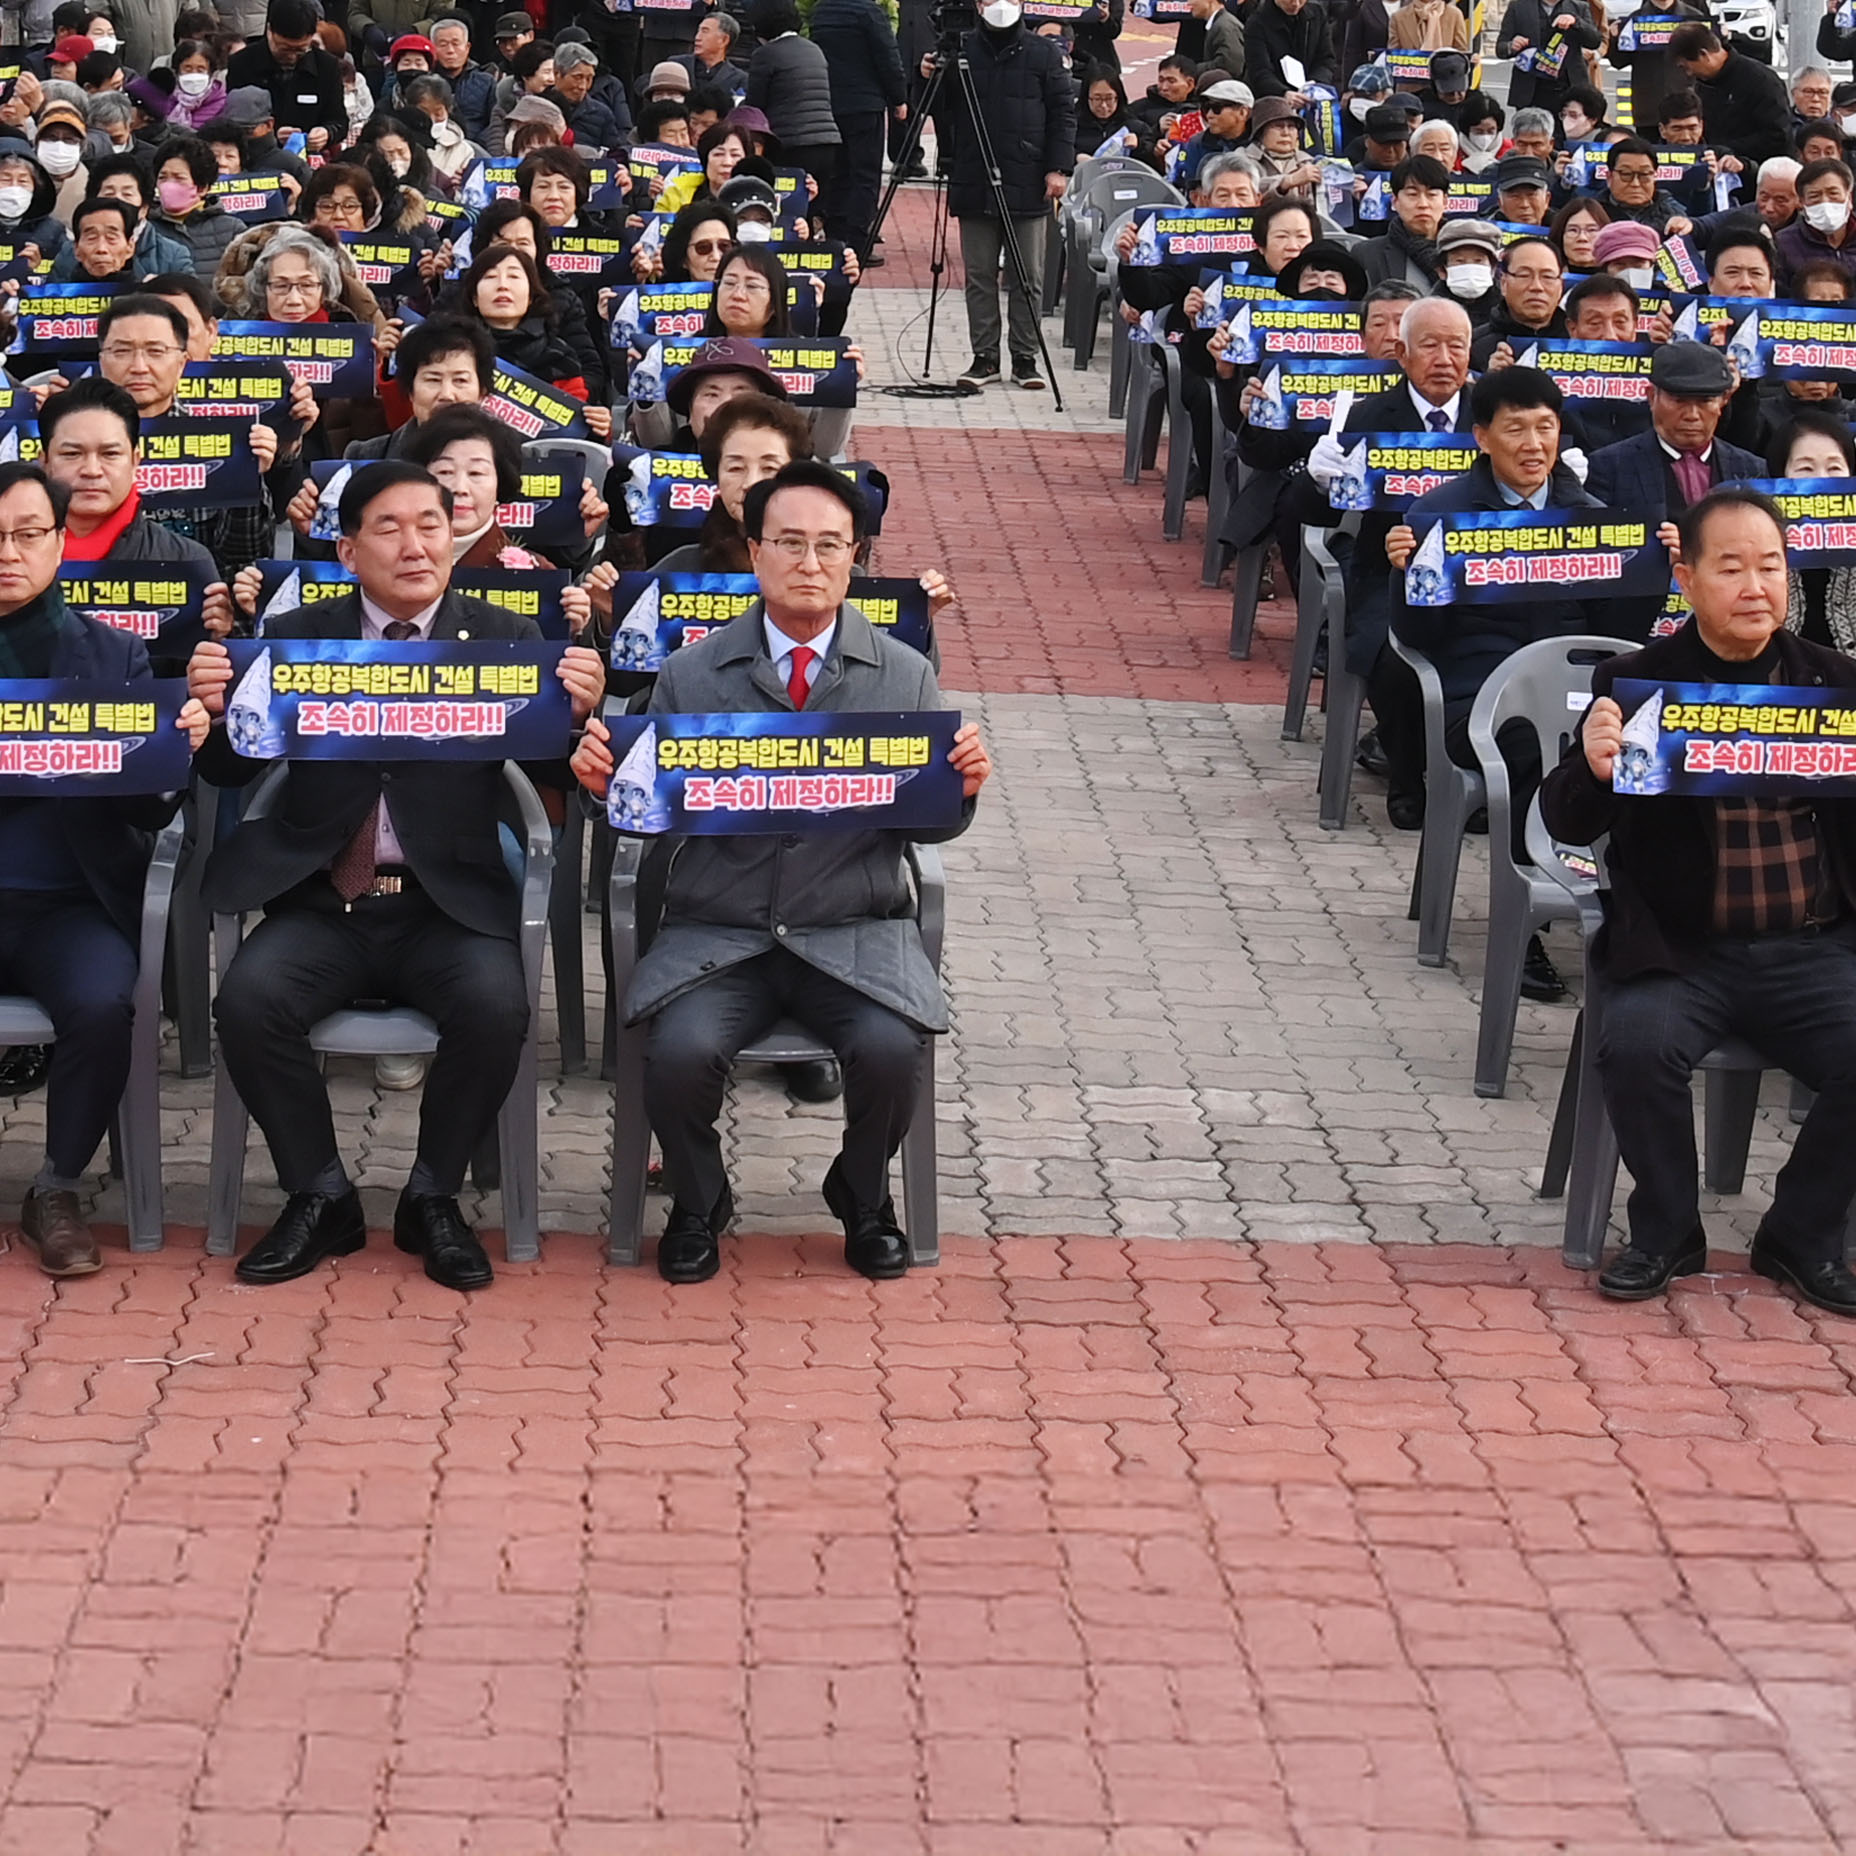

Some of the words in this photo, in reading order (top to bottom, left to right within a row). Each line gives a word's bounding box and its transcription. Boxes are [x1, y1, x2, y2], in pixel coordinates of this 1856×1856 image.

[770, 350, 795, 369] 건설
[799, 350, 836, 369] 특별법
[1776, 345, 1829, 365] 조속히
[148, 434, 180, 460] 건설
[184, 433, 232, 458] 특별법
[1447, 527, 1564, 554] 우주항공복합도시
[1567, 527, 1597, 549] 건설
[1602, 524, 1645, 547] 특별법
[1467, 558, 1530, 584] 조속히
[1529, 554, 1620, 581] 제정하라!!
[274, 664, 430, 695] 우주항공복합도시
[437, 666, 475, 695] 건설
[481, 665, 539, 695] 특별법
[51, 703, 90, 733] 건설
[96, 703, 155, 733] 특별법
[300, 703, 377, 734] 조속히
[383, 703, 504, 735] 제정하라!!
[1663, 704, 1817, 734] 우주항공복합도시
[660, 738, 819, 770] 우주항공복합도시
[825, 738, 865, 768] 건설
[871, 737, 930, 767] 특별법
[1686, 741, 1763, 772] 조속히
[686, 777, 765, 809] 조속히
[771, 776, 894, 808] 제정하라!!
